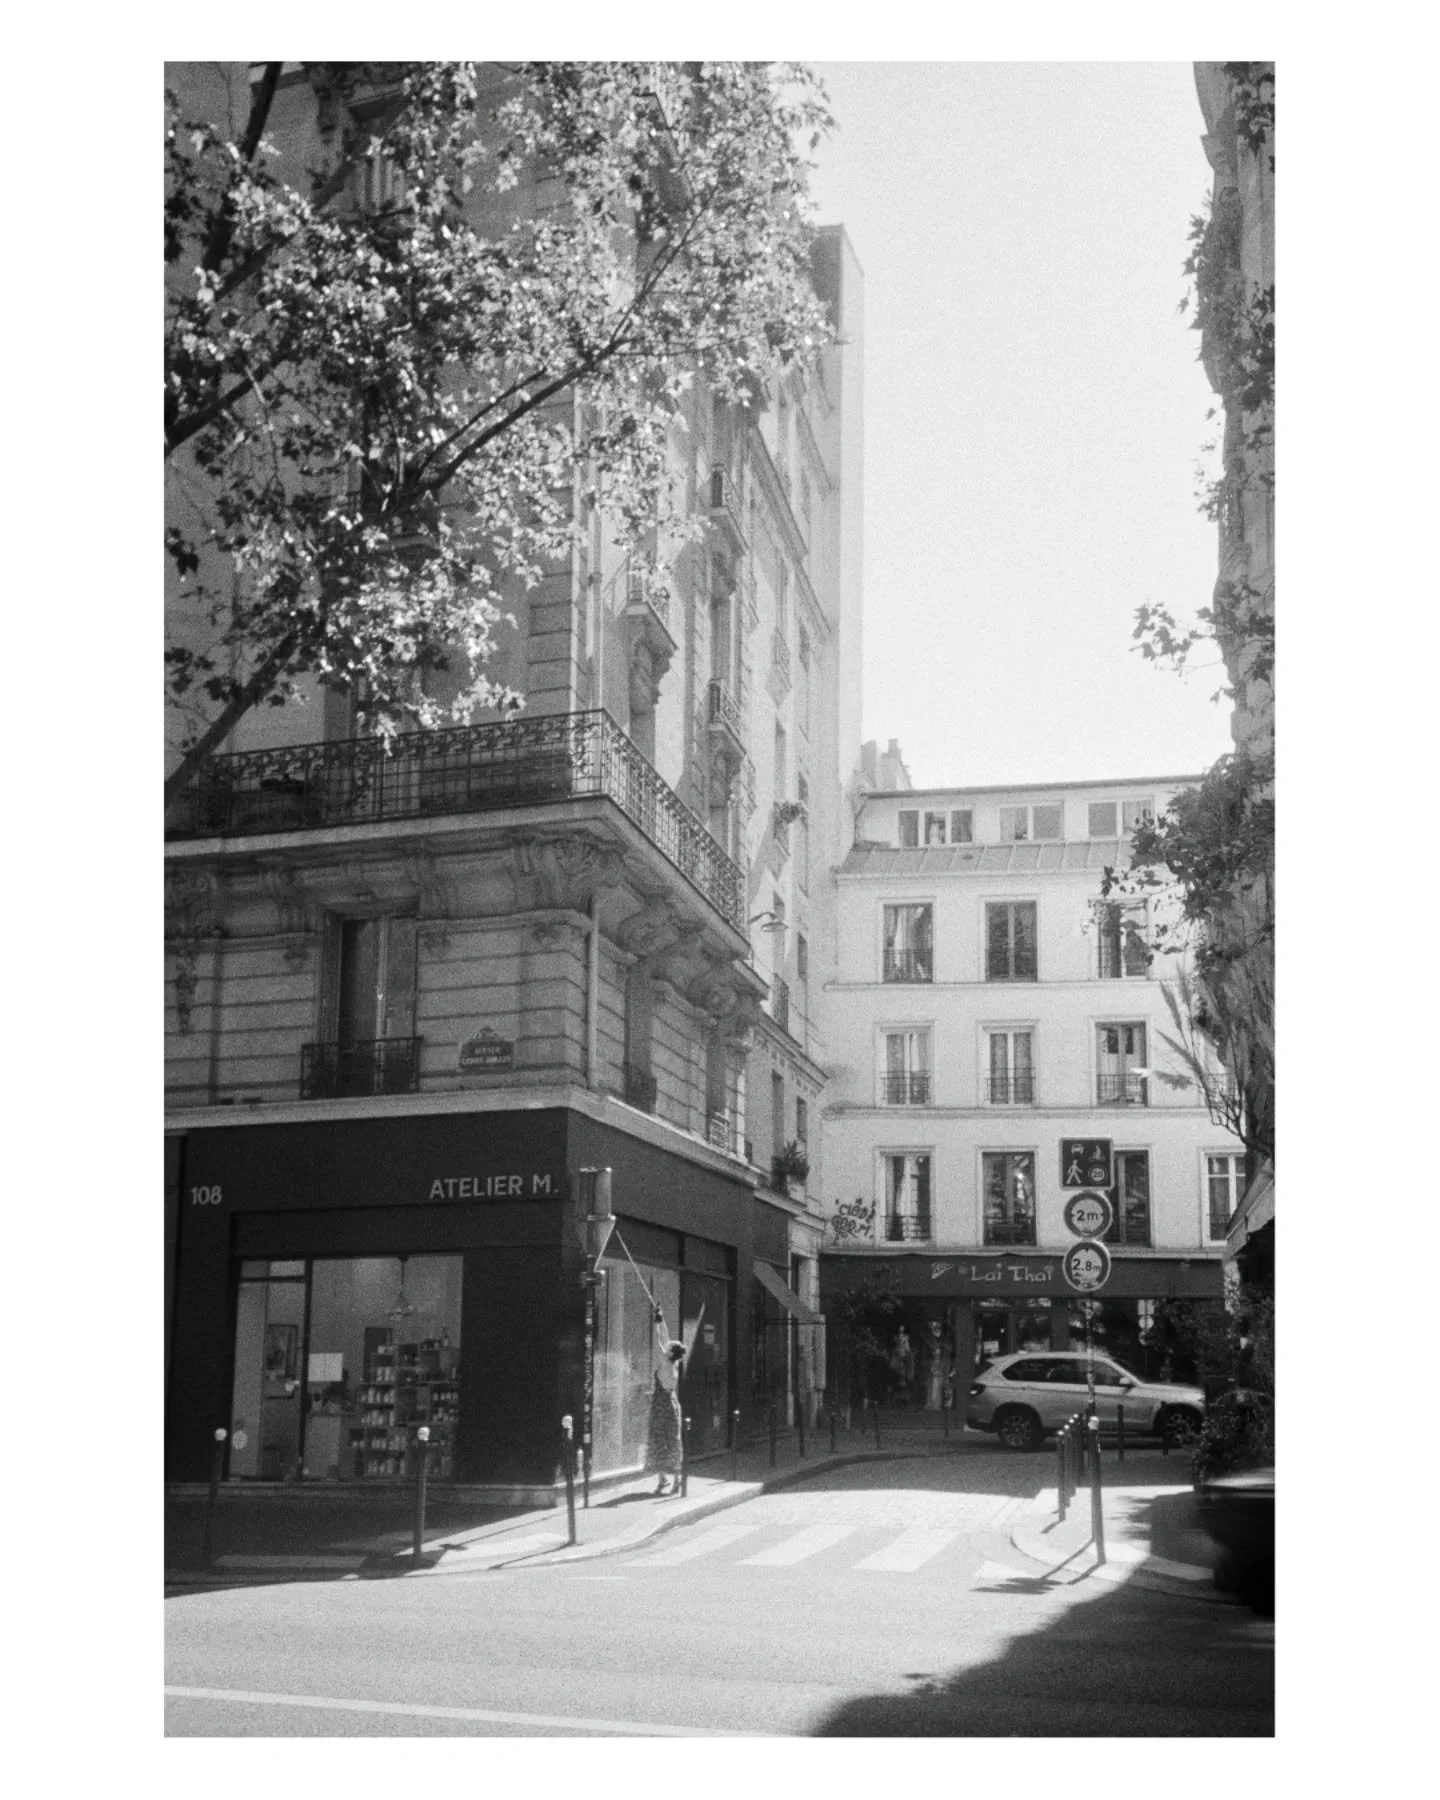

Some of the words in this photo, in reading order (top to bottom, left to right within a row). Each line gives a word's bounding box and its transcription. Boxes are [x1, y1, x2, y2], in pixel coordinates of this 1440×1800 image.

[191, 1185, 222, 1205] 108
[429, 1175, 523, 1199] ATELIER
[532, 1173, 560, 1195] M.
[971, 1263, 1002, 1281] Lai
